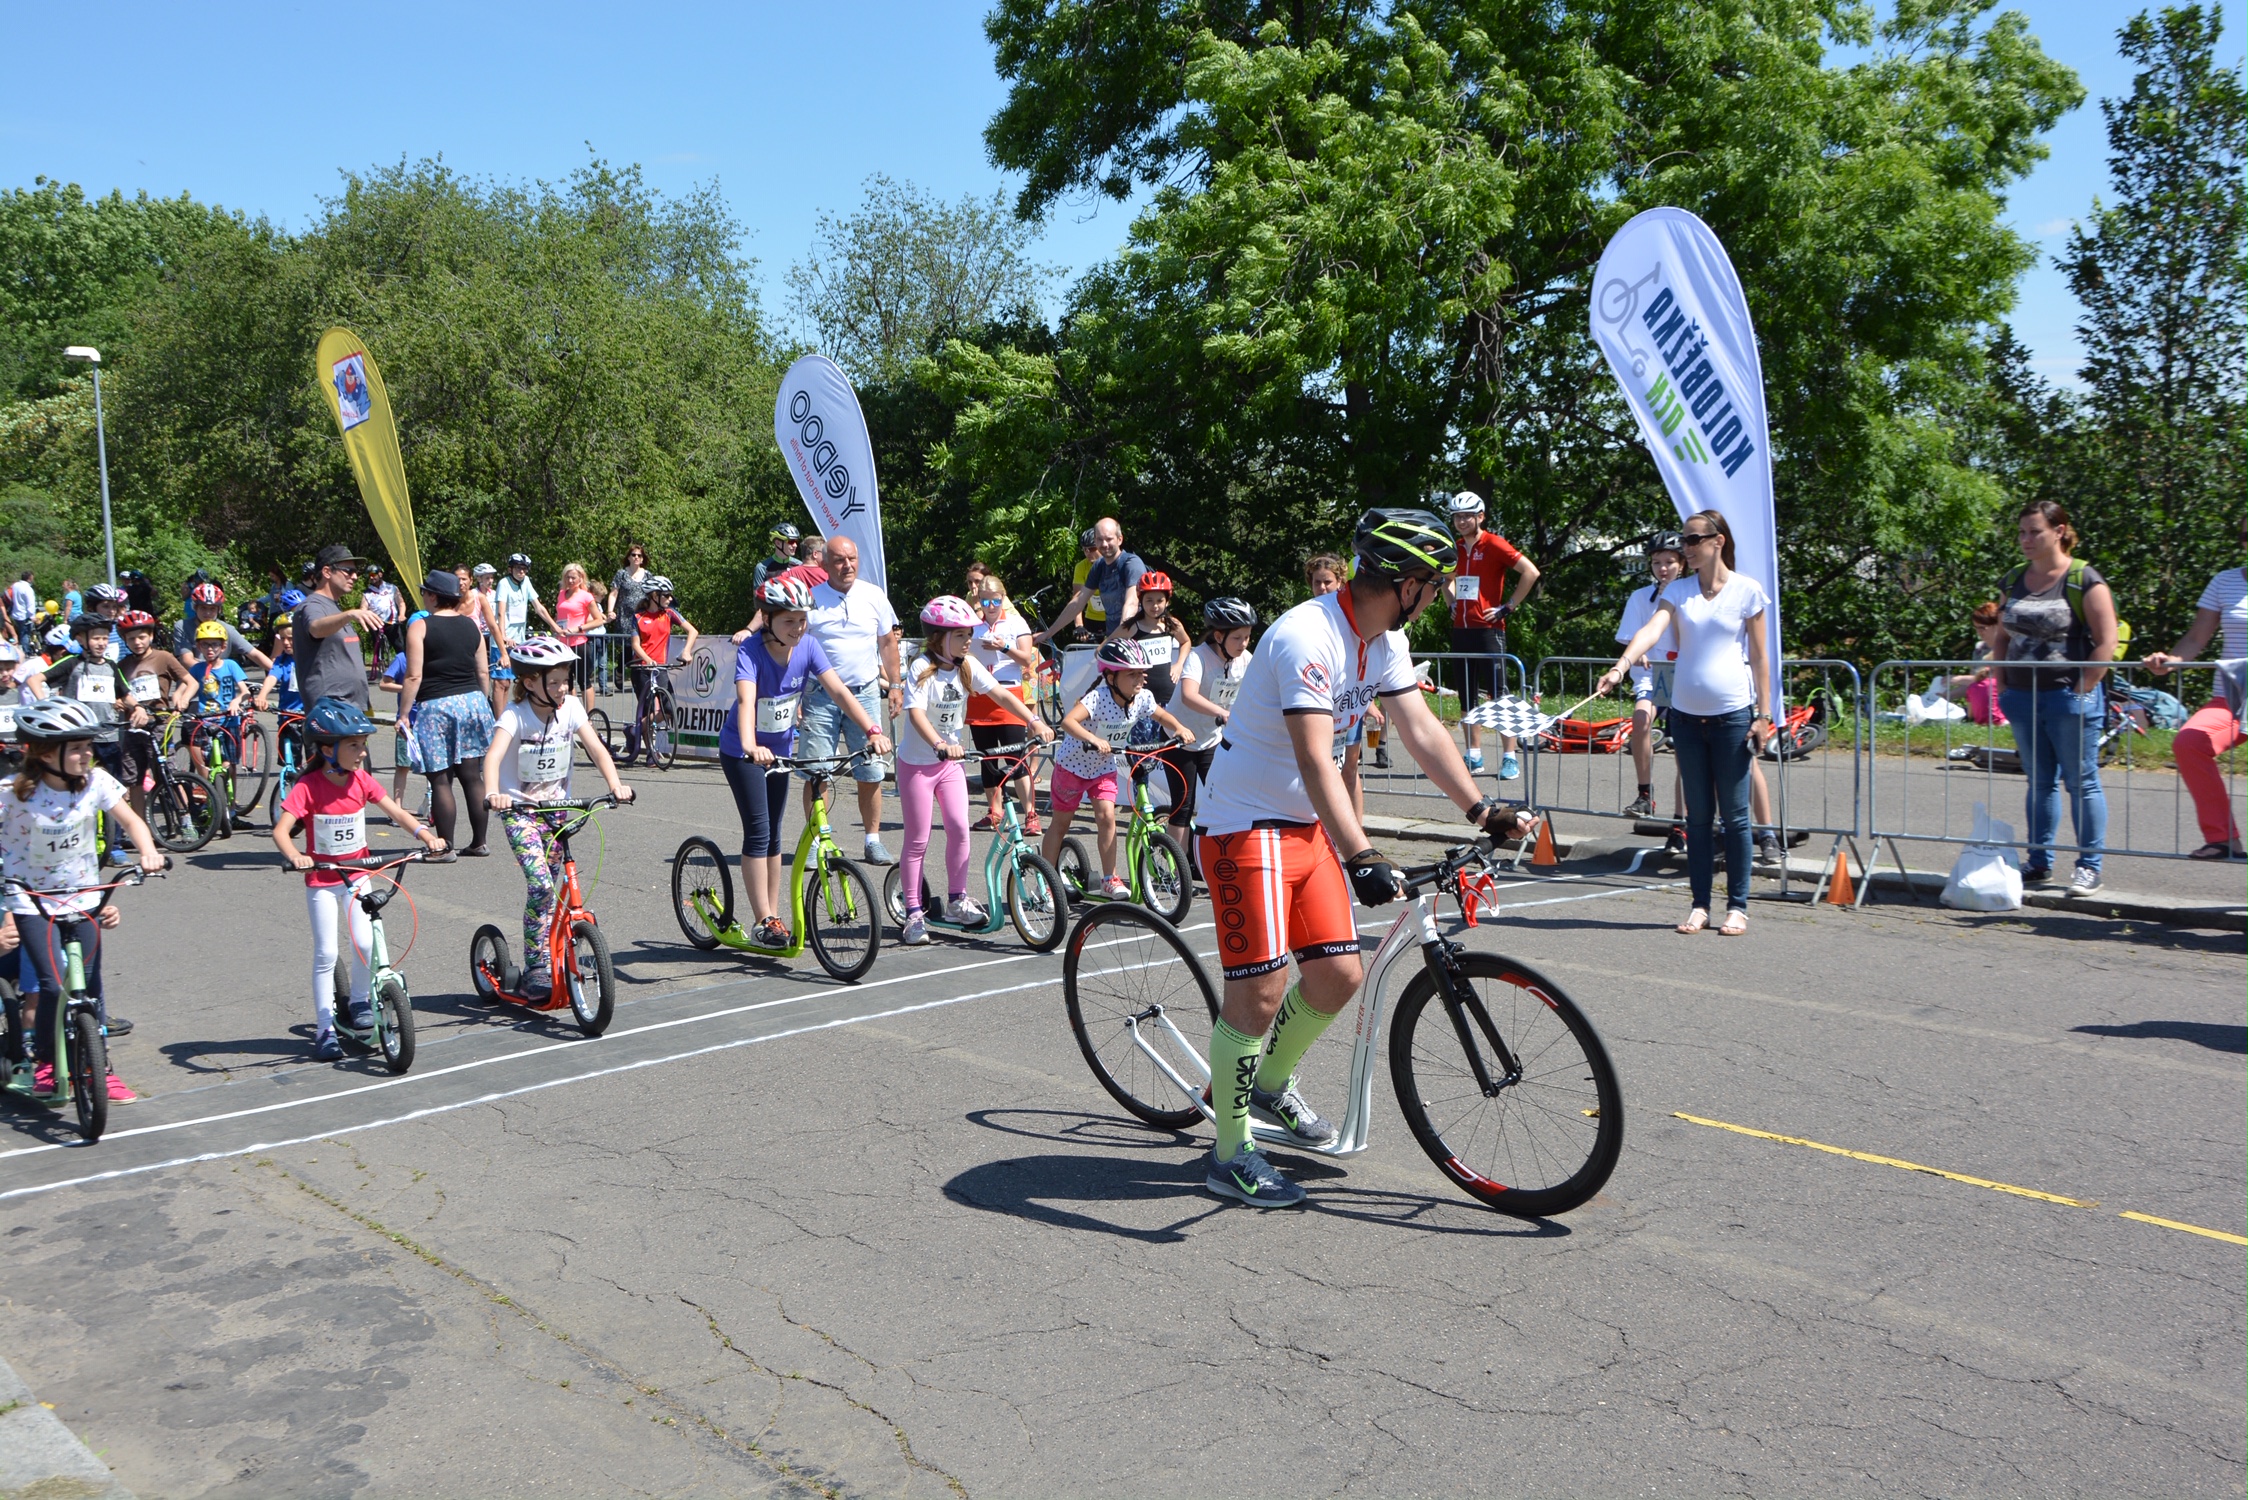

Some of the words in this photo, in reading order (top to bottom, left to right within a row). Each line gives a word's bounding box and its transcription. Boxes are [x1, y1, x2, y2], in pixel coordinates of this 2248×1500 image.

[1459, 584, 1469, 592] 72
[1148, 647, 1167, 656] 103
[135, 685, 147, 693] 84
[668, 706, 730, 732] OLEKTO
[774, 708, 789, 721] 82
[940, 712, 955, 723] 51
[1106, 731, 1127, 741] 102
[994, 744, 1021, 754] WZOOM
[537, 758, 556, 770] 52
[548, 799, 583, 807] WZOOM
[334, 829, 355, 842] 55
[47, 833, 80, 852] 145
[361, 856, 383, 865] TIDIT
[1323, 945, 1344, 954] You
[1231, 968, 1248, 977] run
[1250, 963, 1270, 974] out
[1271, 957, 1281, 968] of
